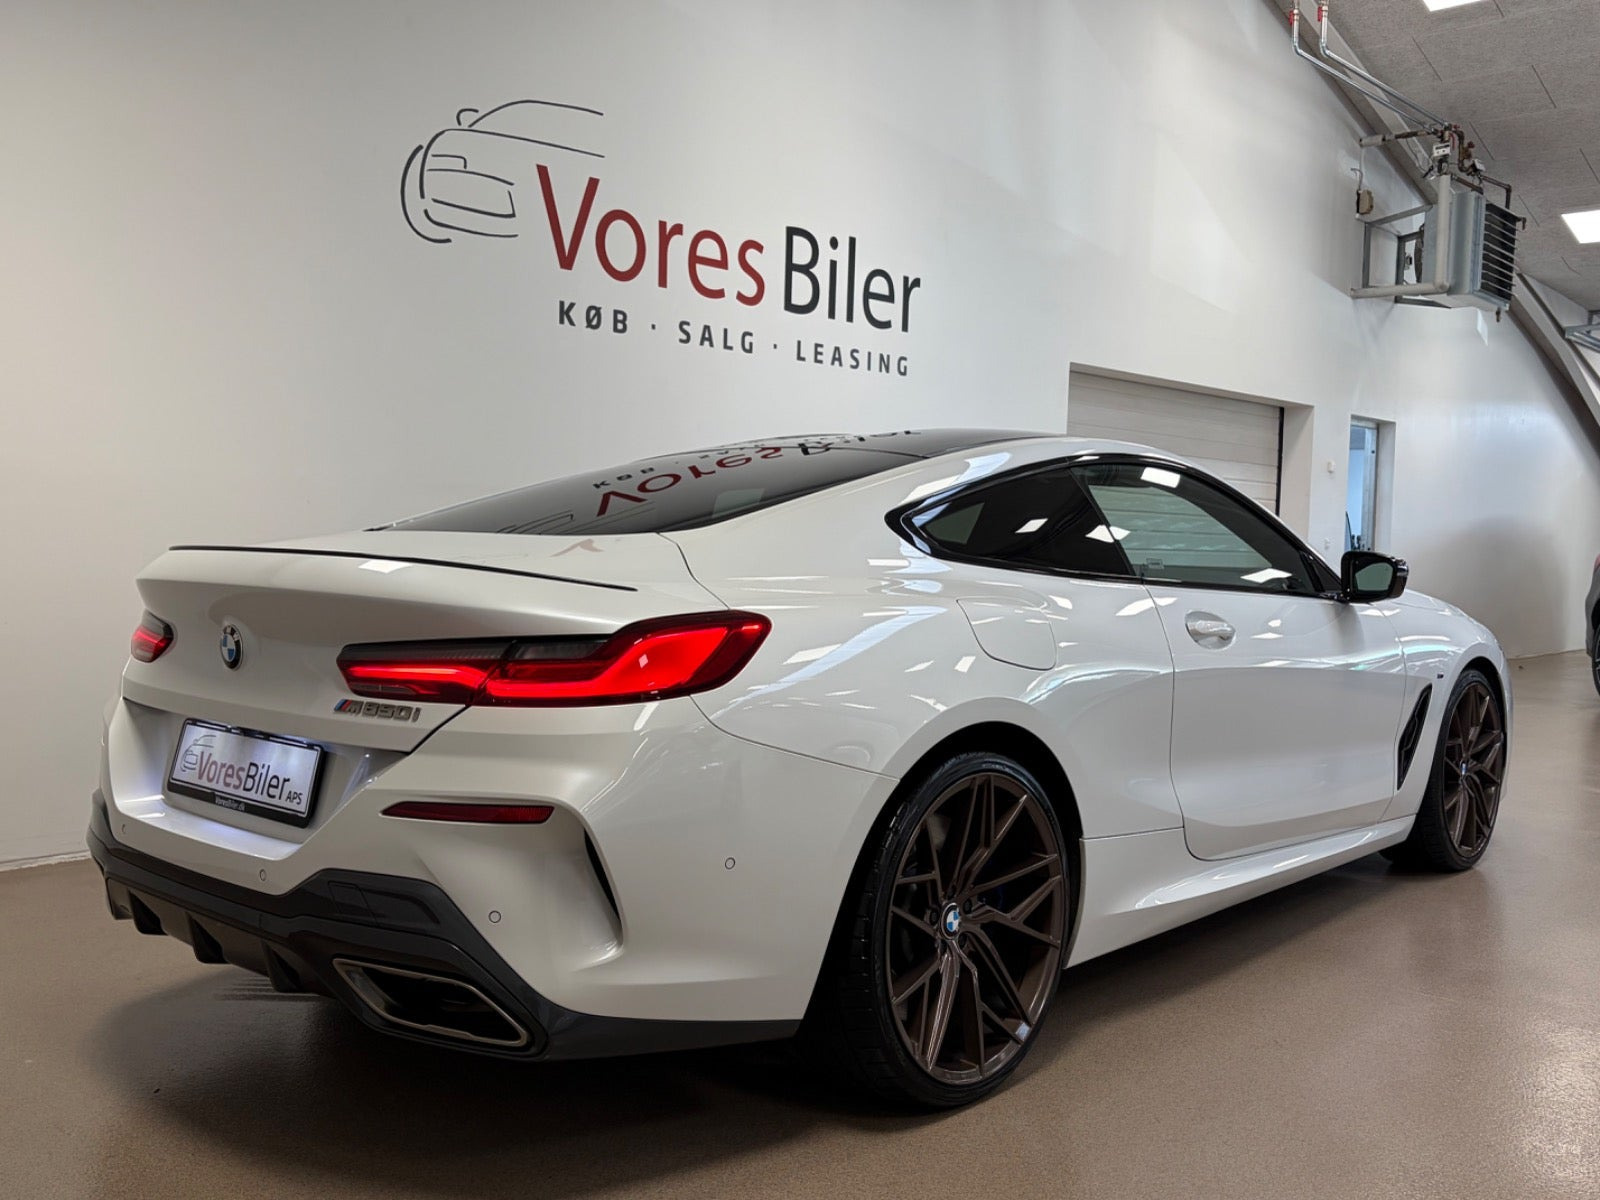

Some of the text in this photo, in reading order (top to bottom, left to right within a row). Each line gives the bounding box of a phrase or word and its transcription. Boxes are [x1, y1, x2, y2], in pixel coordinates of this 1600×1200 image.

[536, 163, 921, 333] Vores Biler
[558, 300, 908, 377] KØB SALG LEASING
[285, 790, 303, 805] APS
